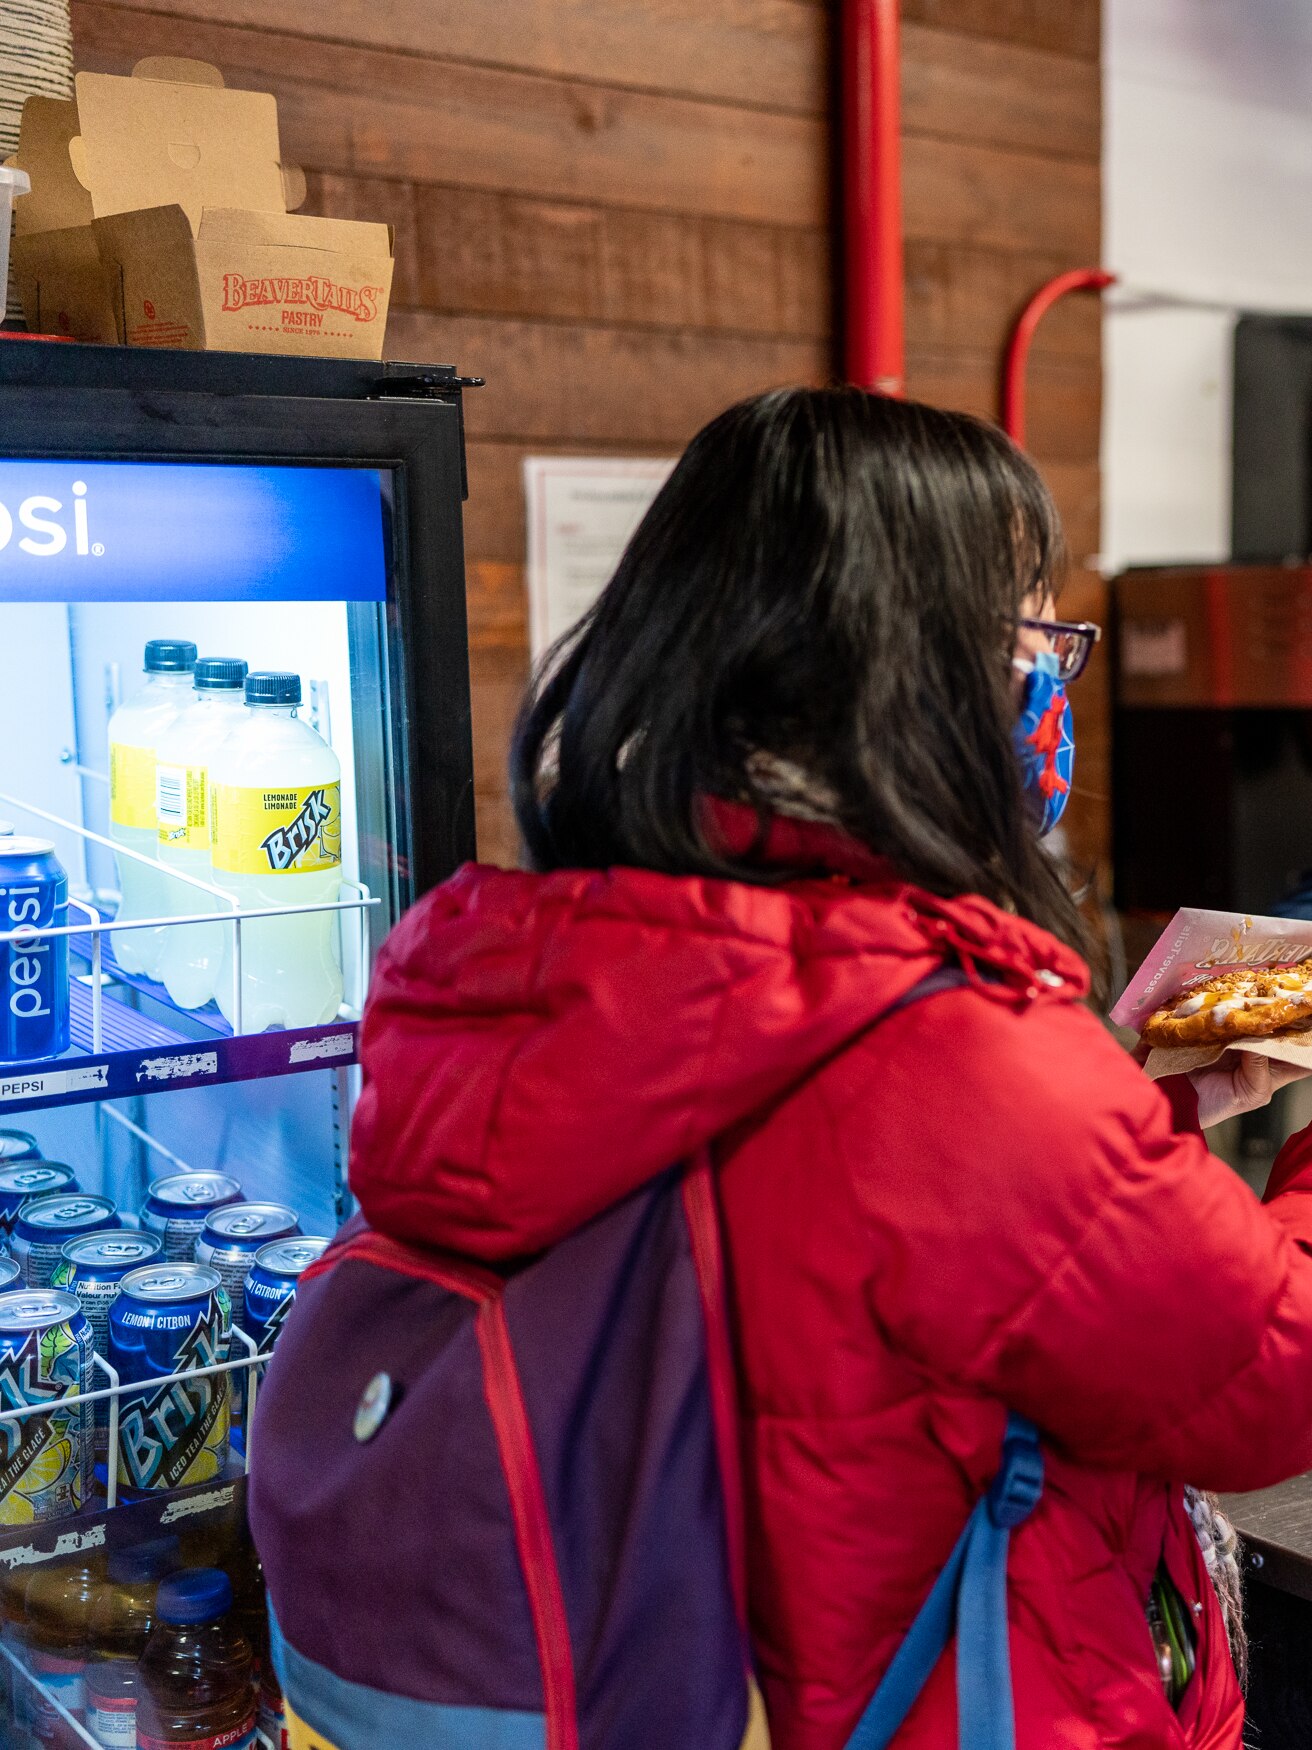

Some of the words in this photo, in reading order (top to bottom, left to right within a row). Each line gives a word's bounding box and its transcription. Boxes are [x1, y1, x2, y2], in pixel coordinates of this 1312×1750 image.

[281, 310, 324, 327] PASTRY
[282, 326, 304, 335] SINCE
[263, 793, 298, 802] LEMONADE
[263, 801, 298, 811] LIMONADE
[0, 886, 50, 1018] pepsi
[1, 1080, 44, 1095] PEPSI
[254, 1283, 283, 1300] CITRON
[121, 1311, 151, 1328] LEMON
[156, 1314, 191, 1329] CITRON
[22, 1426, 46, 1460] GLACÉ
[169, 1457, 188, 1481] ICED
[186, 1437, 200, 1458] TEA
[212, 1721, 249, 1750] APPLE
